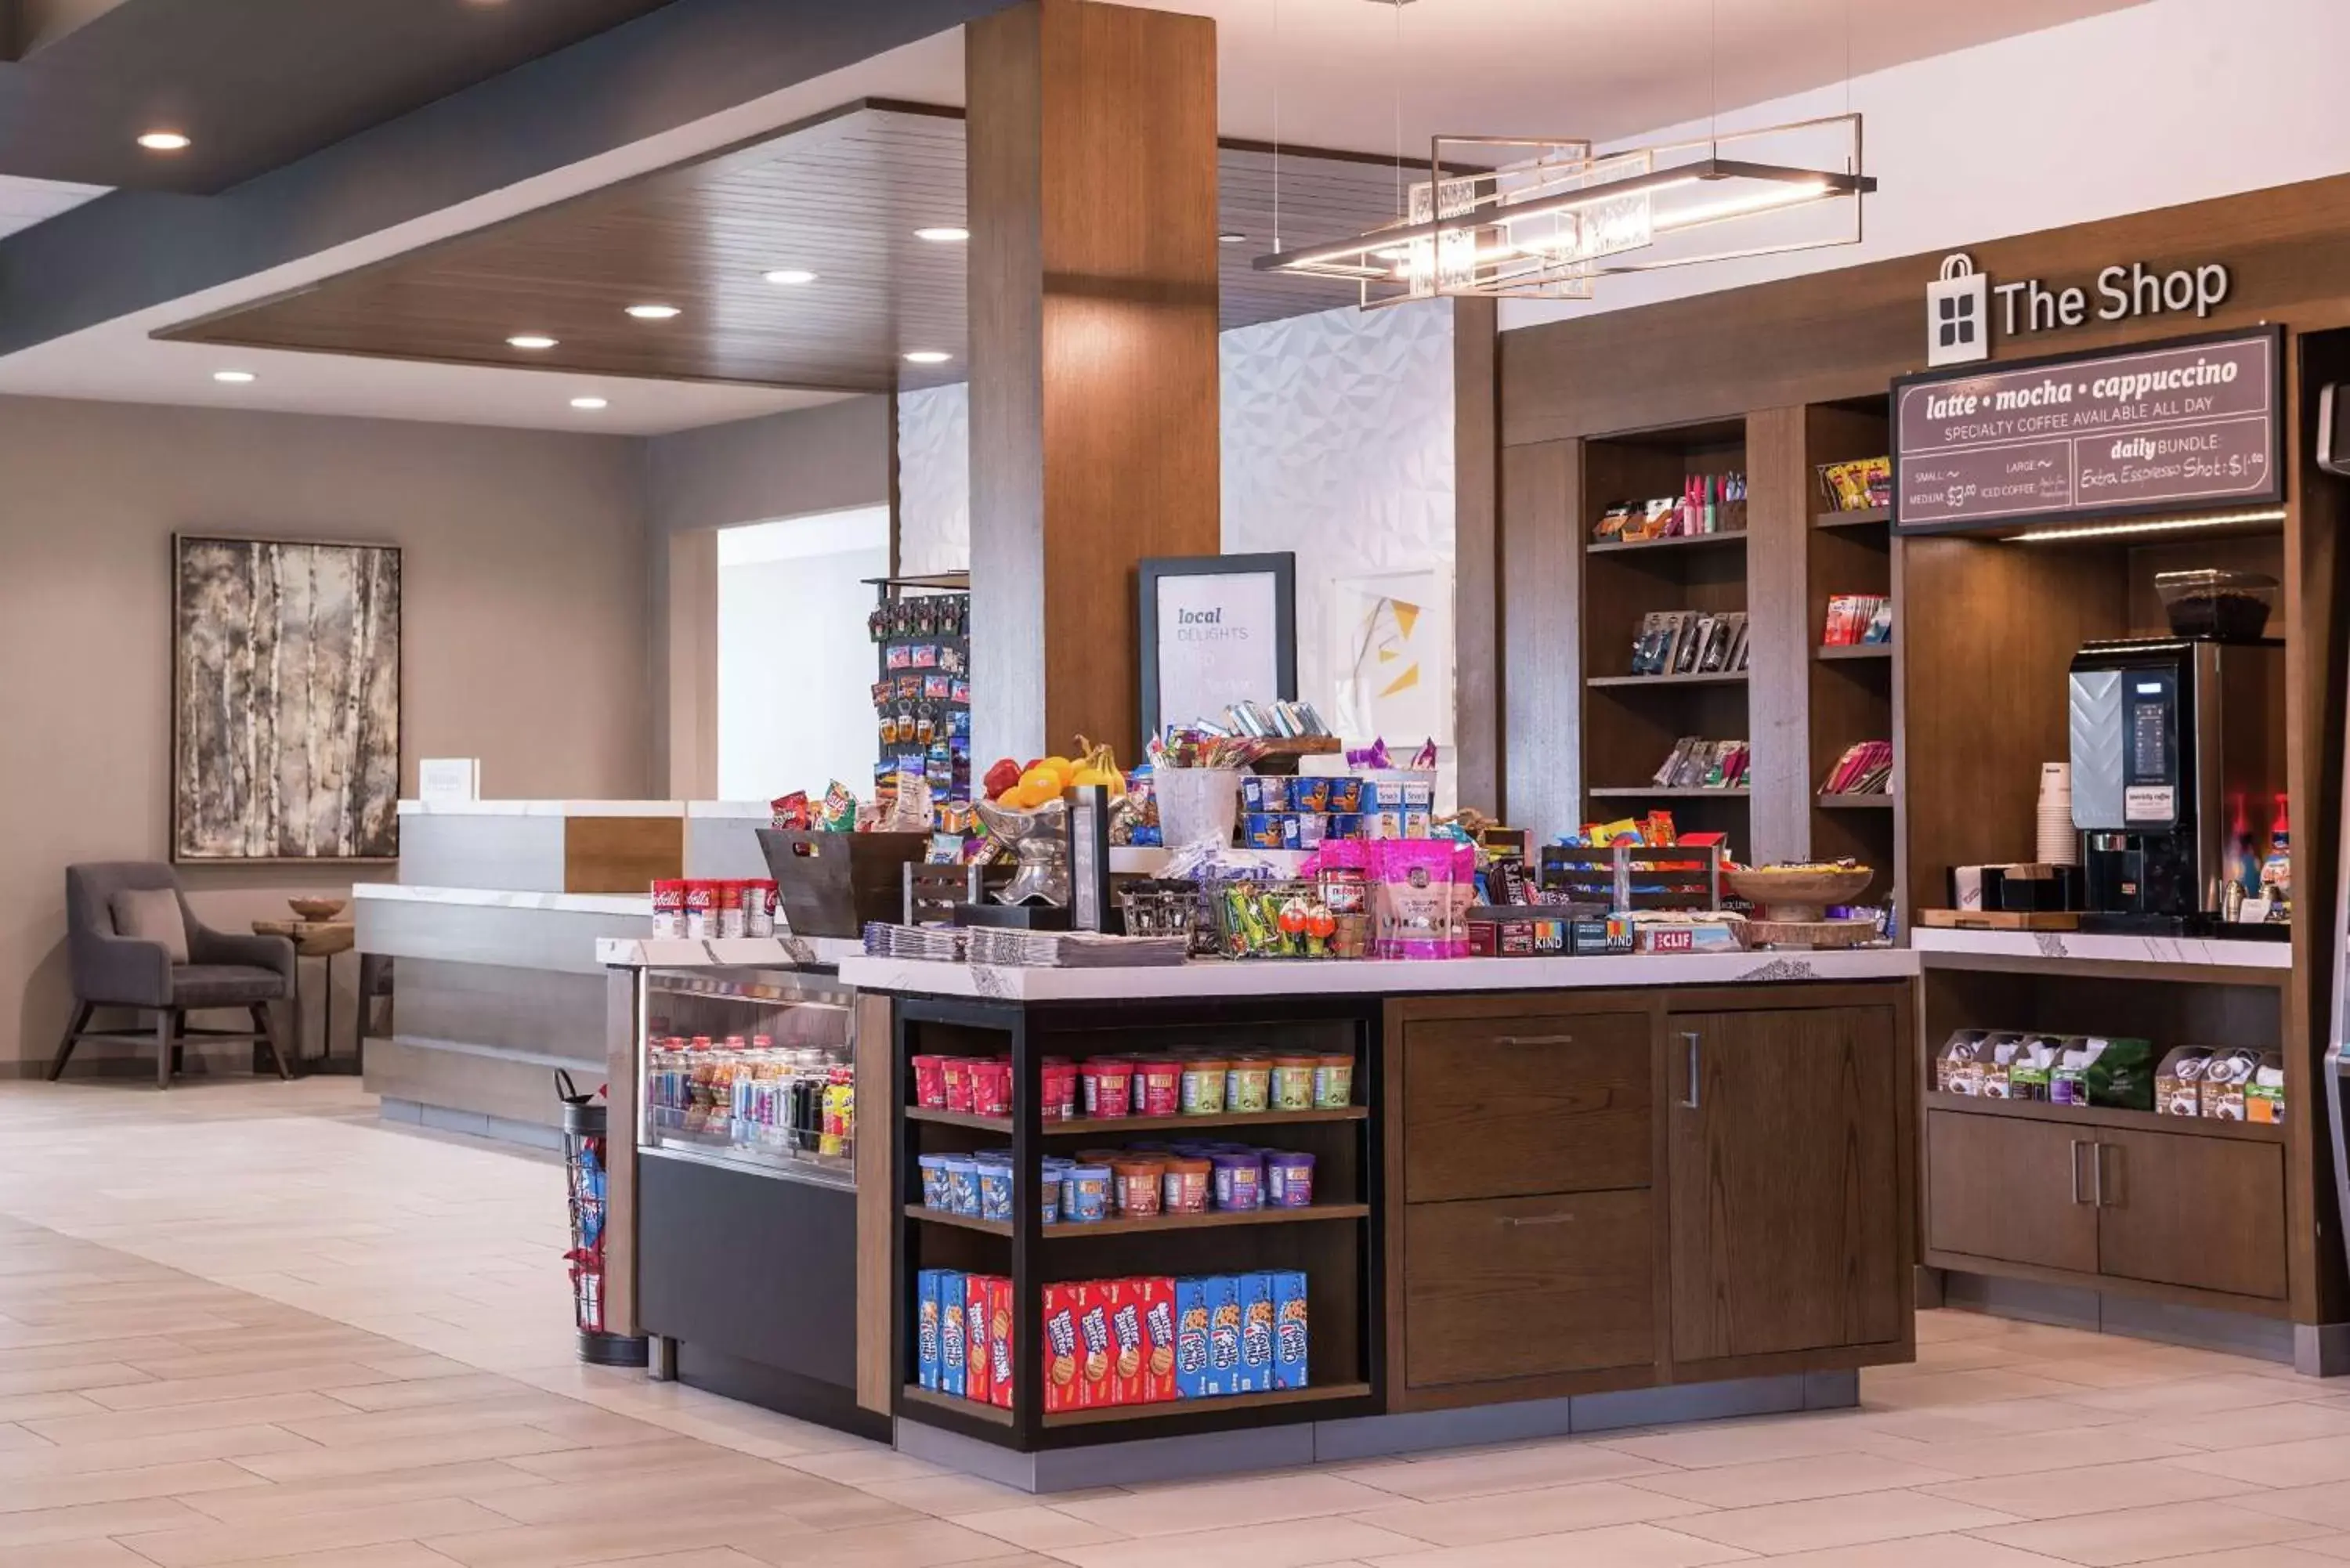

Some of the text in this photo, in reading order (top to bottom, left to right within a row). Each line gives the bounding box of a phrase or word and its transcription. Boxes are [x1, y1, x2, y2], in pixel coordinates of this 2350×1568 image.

[1994, 262, 2228, 334] The Shop
[1926, 357, 2238, 421] latte mocha cappuccino
[1944, 396, 2215, 442] SPECIALTY COFFEE AVAILABLE ALL DAY
[2110, 438, 2156, 461] daily
[2081, 468, 2118, 488] Extra
[1177, 627, 1250, 641] DELIGHTS
[1178, 607, 1221, 624] local
[1535, 936, 1563, 949] KIND
[1607, 934, 1633, 948] KIND
[1663, 933, 1690, 948] CLIF
[1049, 1317, 1068, 1357] Butter
[1058, 1310, 1075, 1353] Nutter
[1082, 1316, 1101, 1354] Butter
[1090, 1306, 1108, 1348] Nutter
[1114, 1312, 1133, 1351] Butter
[1123, 1304, 1140, 1346] Nutter
[1148, 1310, 1166, 1348] Butter
[1156, 1302, 1173, 1342] Nutter
